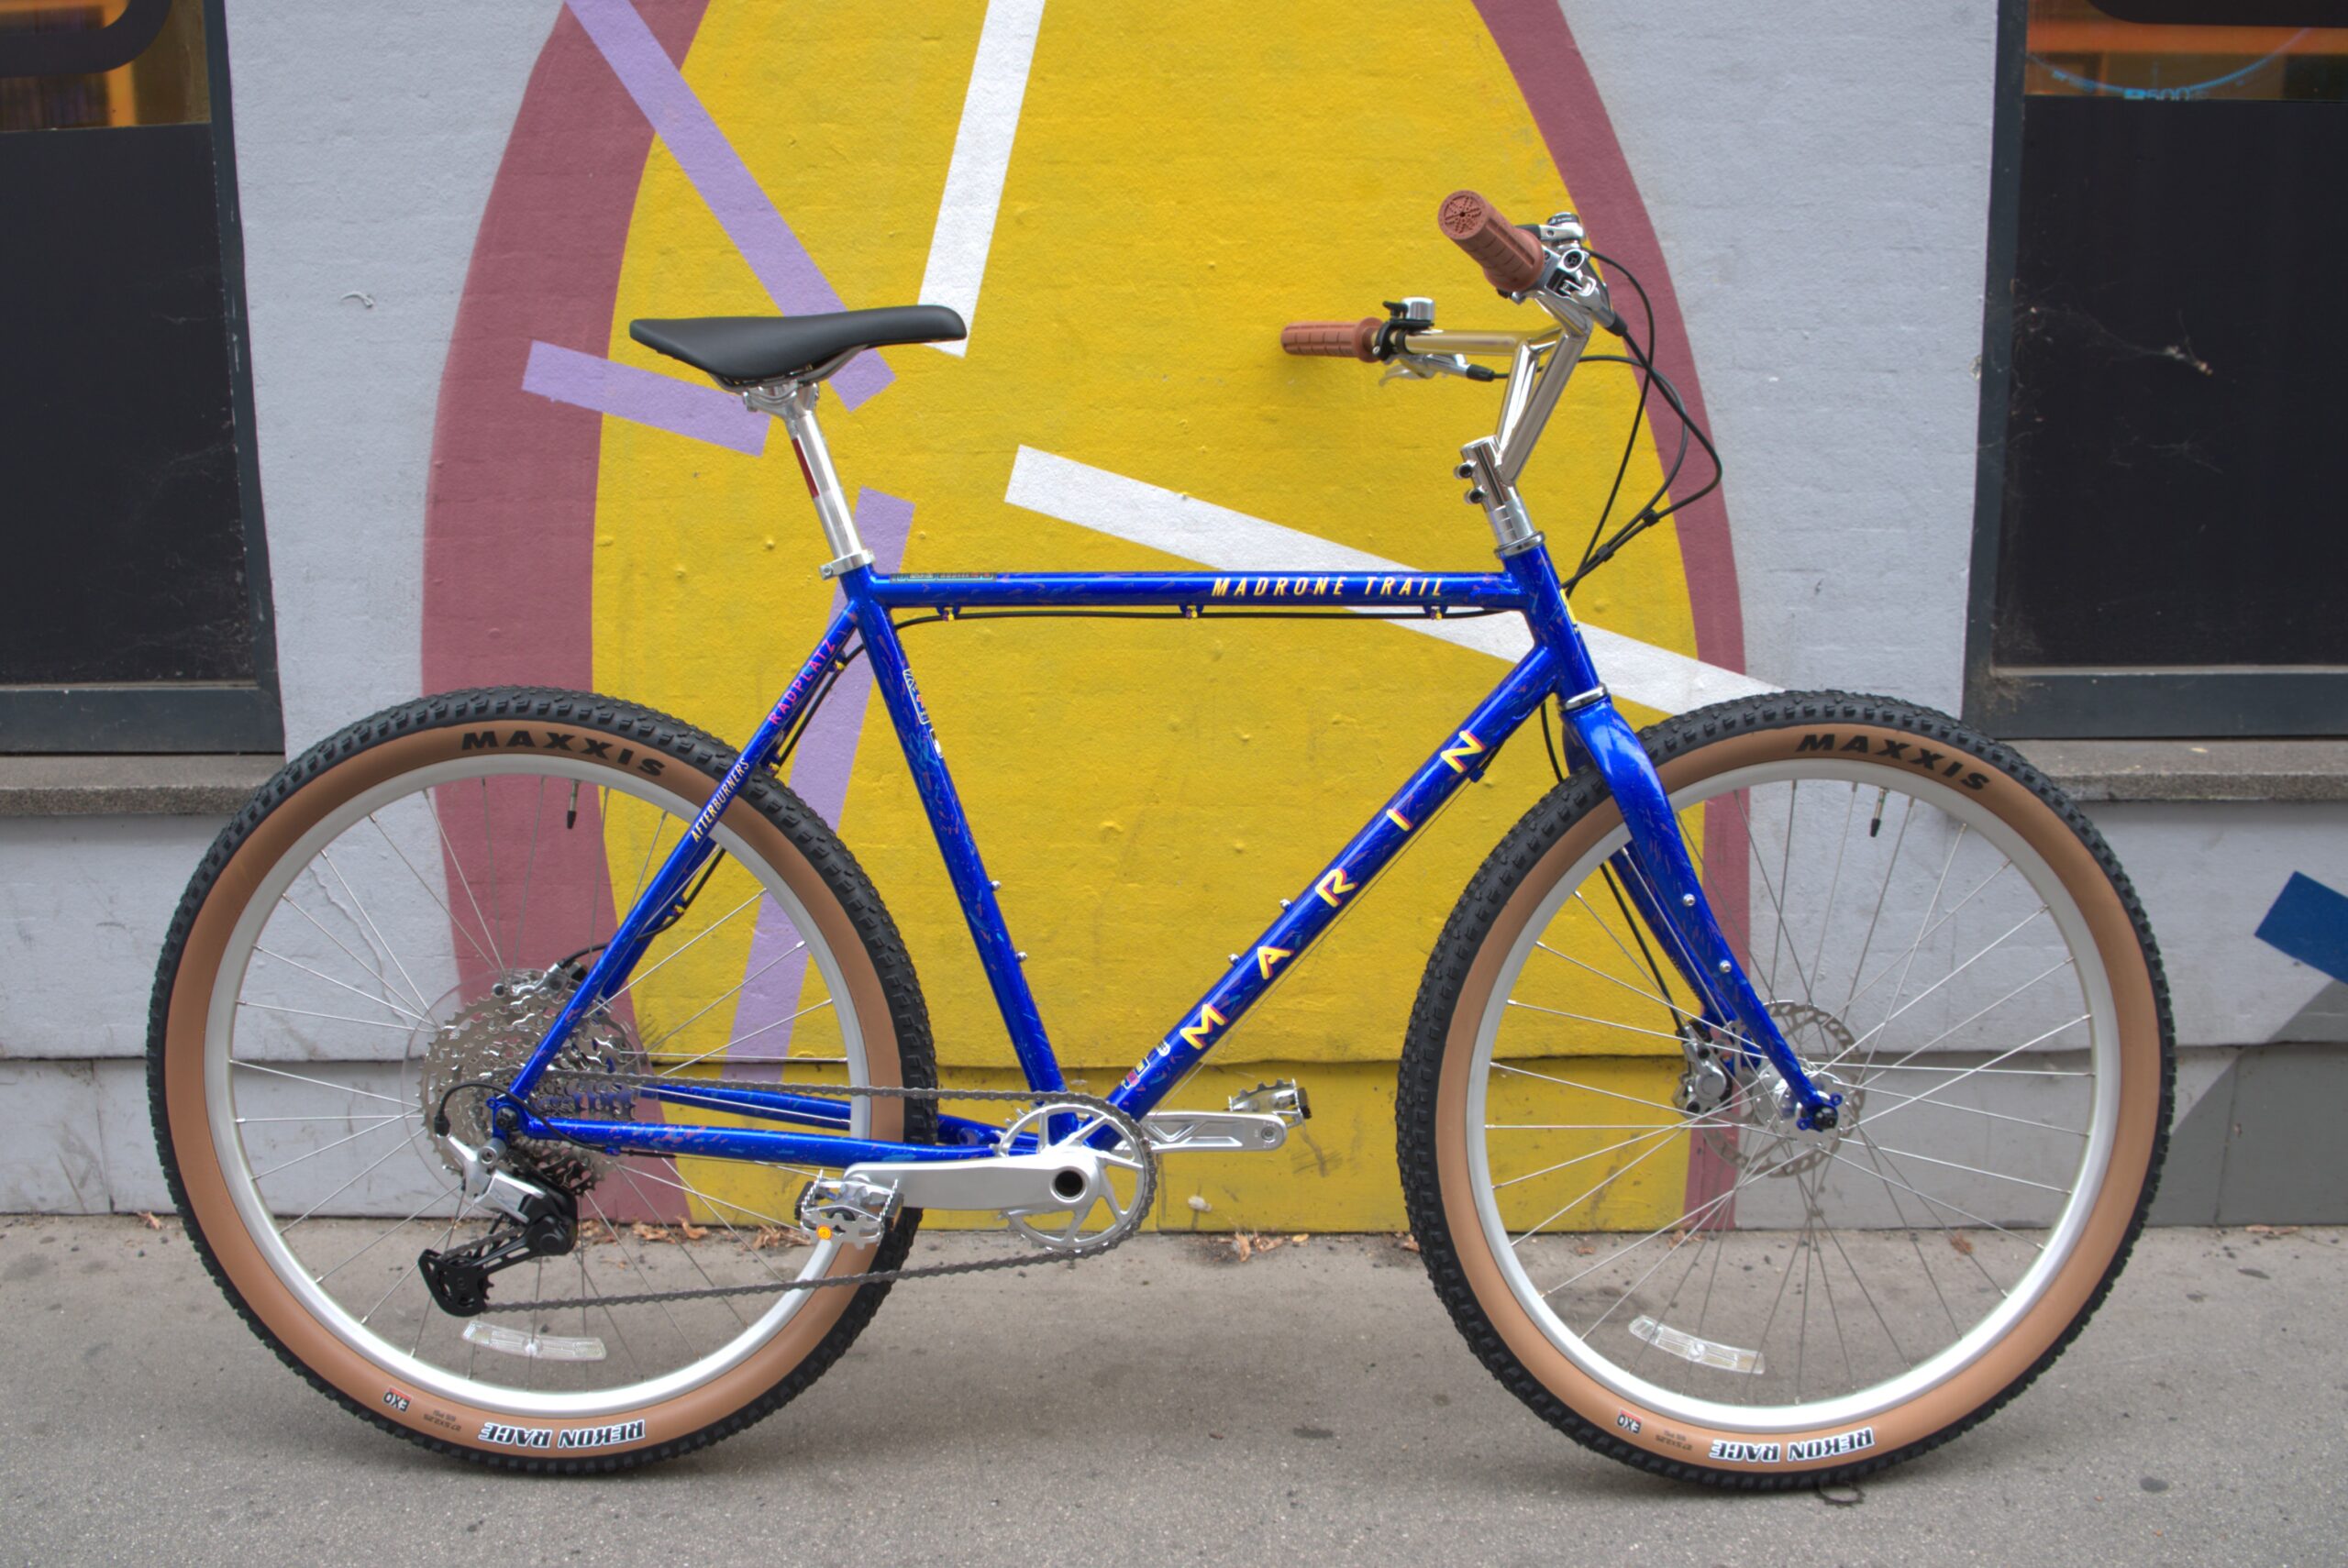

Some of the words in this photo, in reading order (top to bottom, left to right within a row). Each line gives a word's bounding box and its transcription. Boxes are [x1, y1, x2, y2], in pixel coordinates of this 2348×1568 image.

[1212, 577, 1347, 596] MADRONE
[1364, 577, 1443, 596] TRAIL
[768, 639, 836, 725] RADPLATZ
[461, 731, 666, 777] MAXXIS
[1795, 734, 1991, 790] MAXXIS
[691, 757, 750, 843] AFTERBURNERS
[1180, 730, 1486, 1050] MARIN
[383, 1392, 410, 1412] EXO
[478, 1422, 552, 1448] RACE
[558, 1419, 646, 1448] REKON
[1617, 1415, 1642, 1434] EXO
[1710, 1439, 1780, 1463] RACE
[1787, 1427, 1875, 1462] REKON
